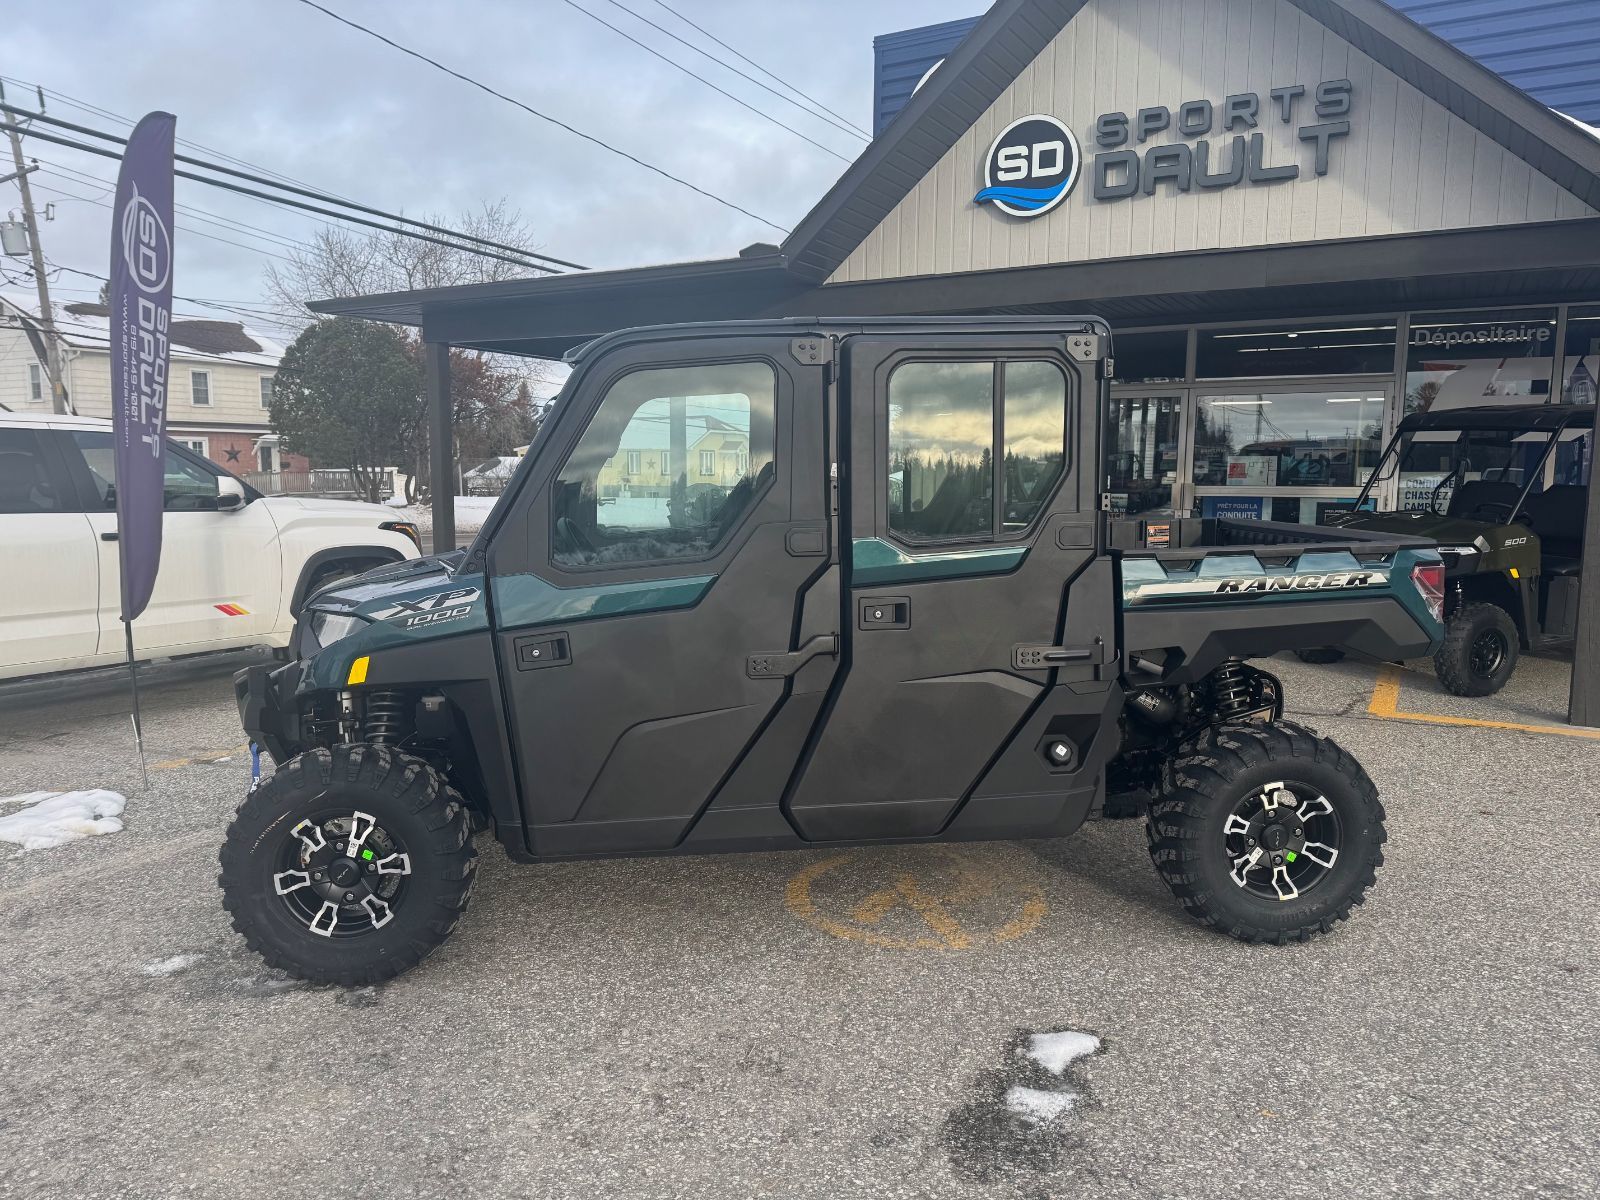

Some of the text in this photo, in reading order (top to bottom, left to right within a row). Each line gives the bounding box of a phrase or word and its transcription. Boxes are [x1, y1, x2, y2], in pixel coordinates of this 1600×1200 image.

[1096, 78, 1353, 147] SPORTS
[996, 140, 1065, 182] SD
[1094, 120, 1351, 201] DAULT
[138, 210, 157, 282] SD
[1414, 325, 1550, 349] Dépositaire
[138, 297, 156, 445] DAULT
[151, 306, 169, 459] SPORTS
[1217, 511, 1258, 520] CONDUITE
[1404, 502, 1447, 512] CAMPZ.
[1504, 537, 1527, 546] 500
[1213, 571, 1375, 595] RANGER
[382, 587, 481, 620] XP
[406, 605, 473, 626] 1000
